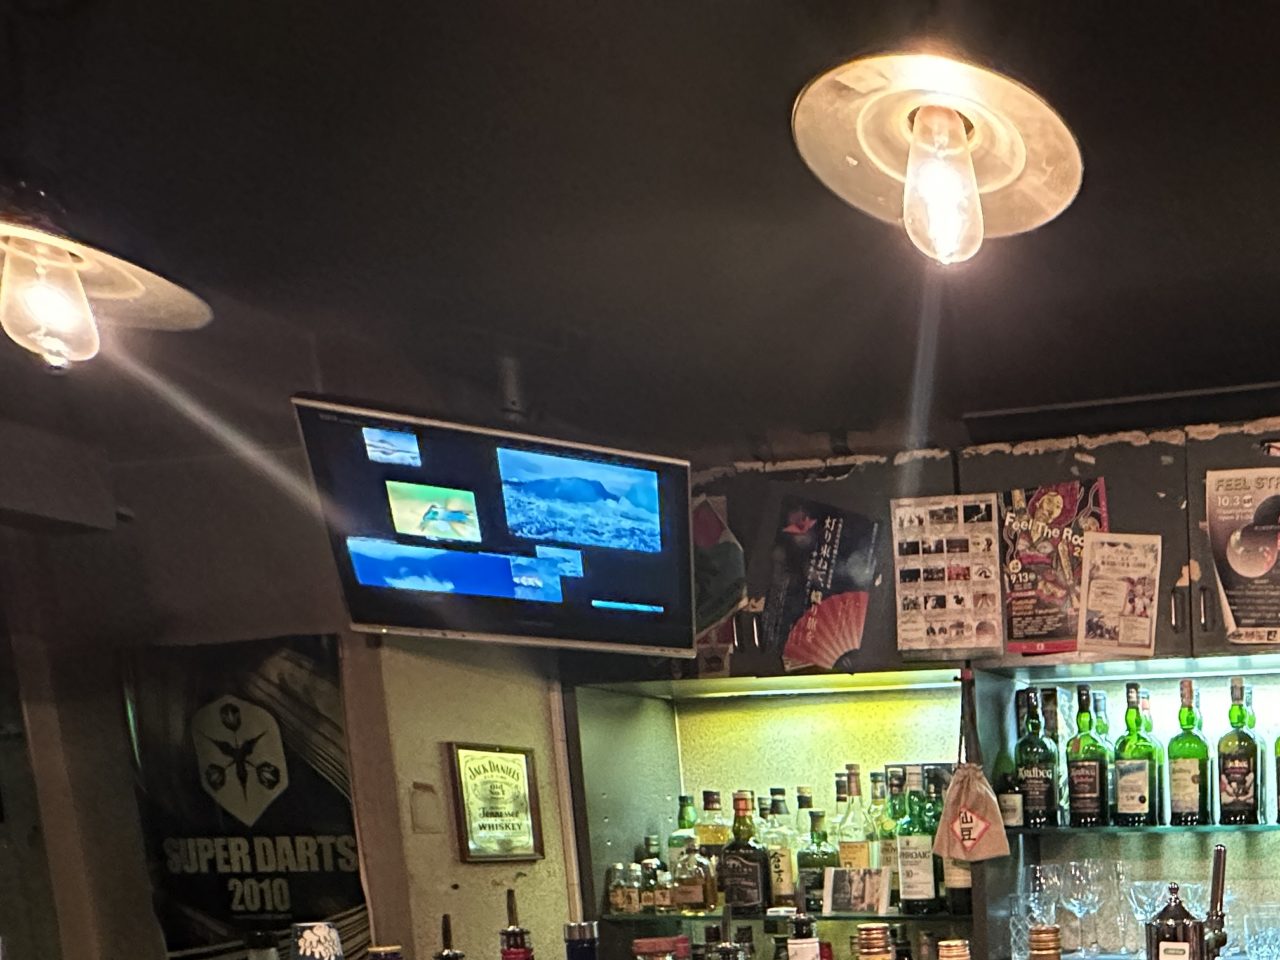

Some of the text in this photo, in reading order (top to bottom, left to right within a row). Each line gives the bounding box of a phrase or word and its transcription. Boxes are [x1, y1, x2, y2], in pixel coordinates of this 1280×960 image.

[1214, 477, 1251, 492] FEEL
[1004, 512, 1032, 531] Feel
[1037, 522, 1060, 538] The
[478, 822, 523, 831] WHISKEY
[163, 835, 357, 874] SUPER DARTS
[227, 878, 291, 913] 2010
